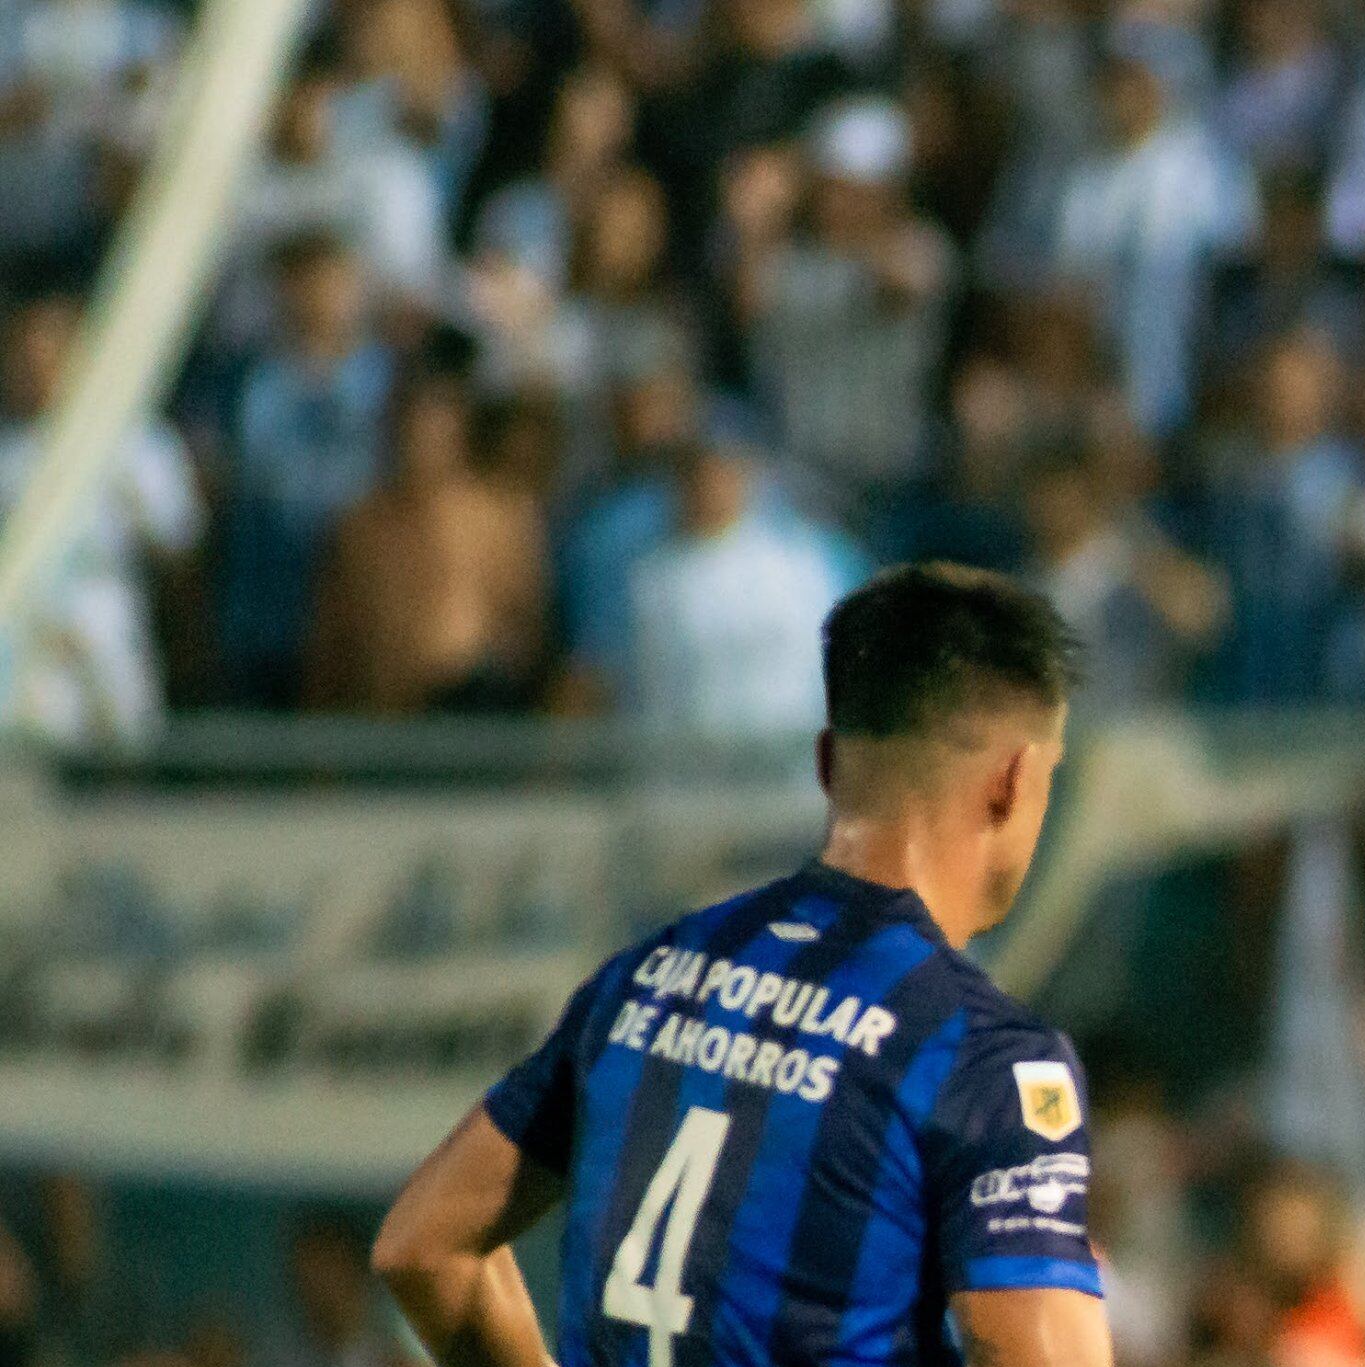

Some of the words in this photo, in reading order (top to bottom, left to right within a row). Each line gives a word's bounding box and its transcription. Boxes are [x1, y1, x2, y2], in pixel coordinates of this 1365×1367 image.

[607, 999, 657, 1050] DE
[650, 1011, 841, 1103] AHORROS
[696, 957, 897, 1057] POPULAR
